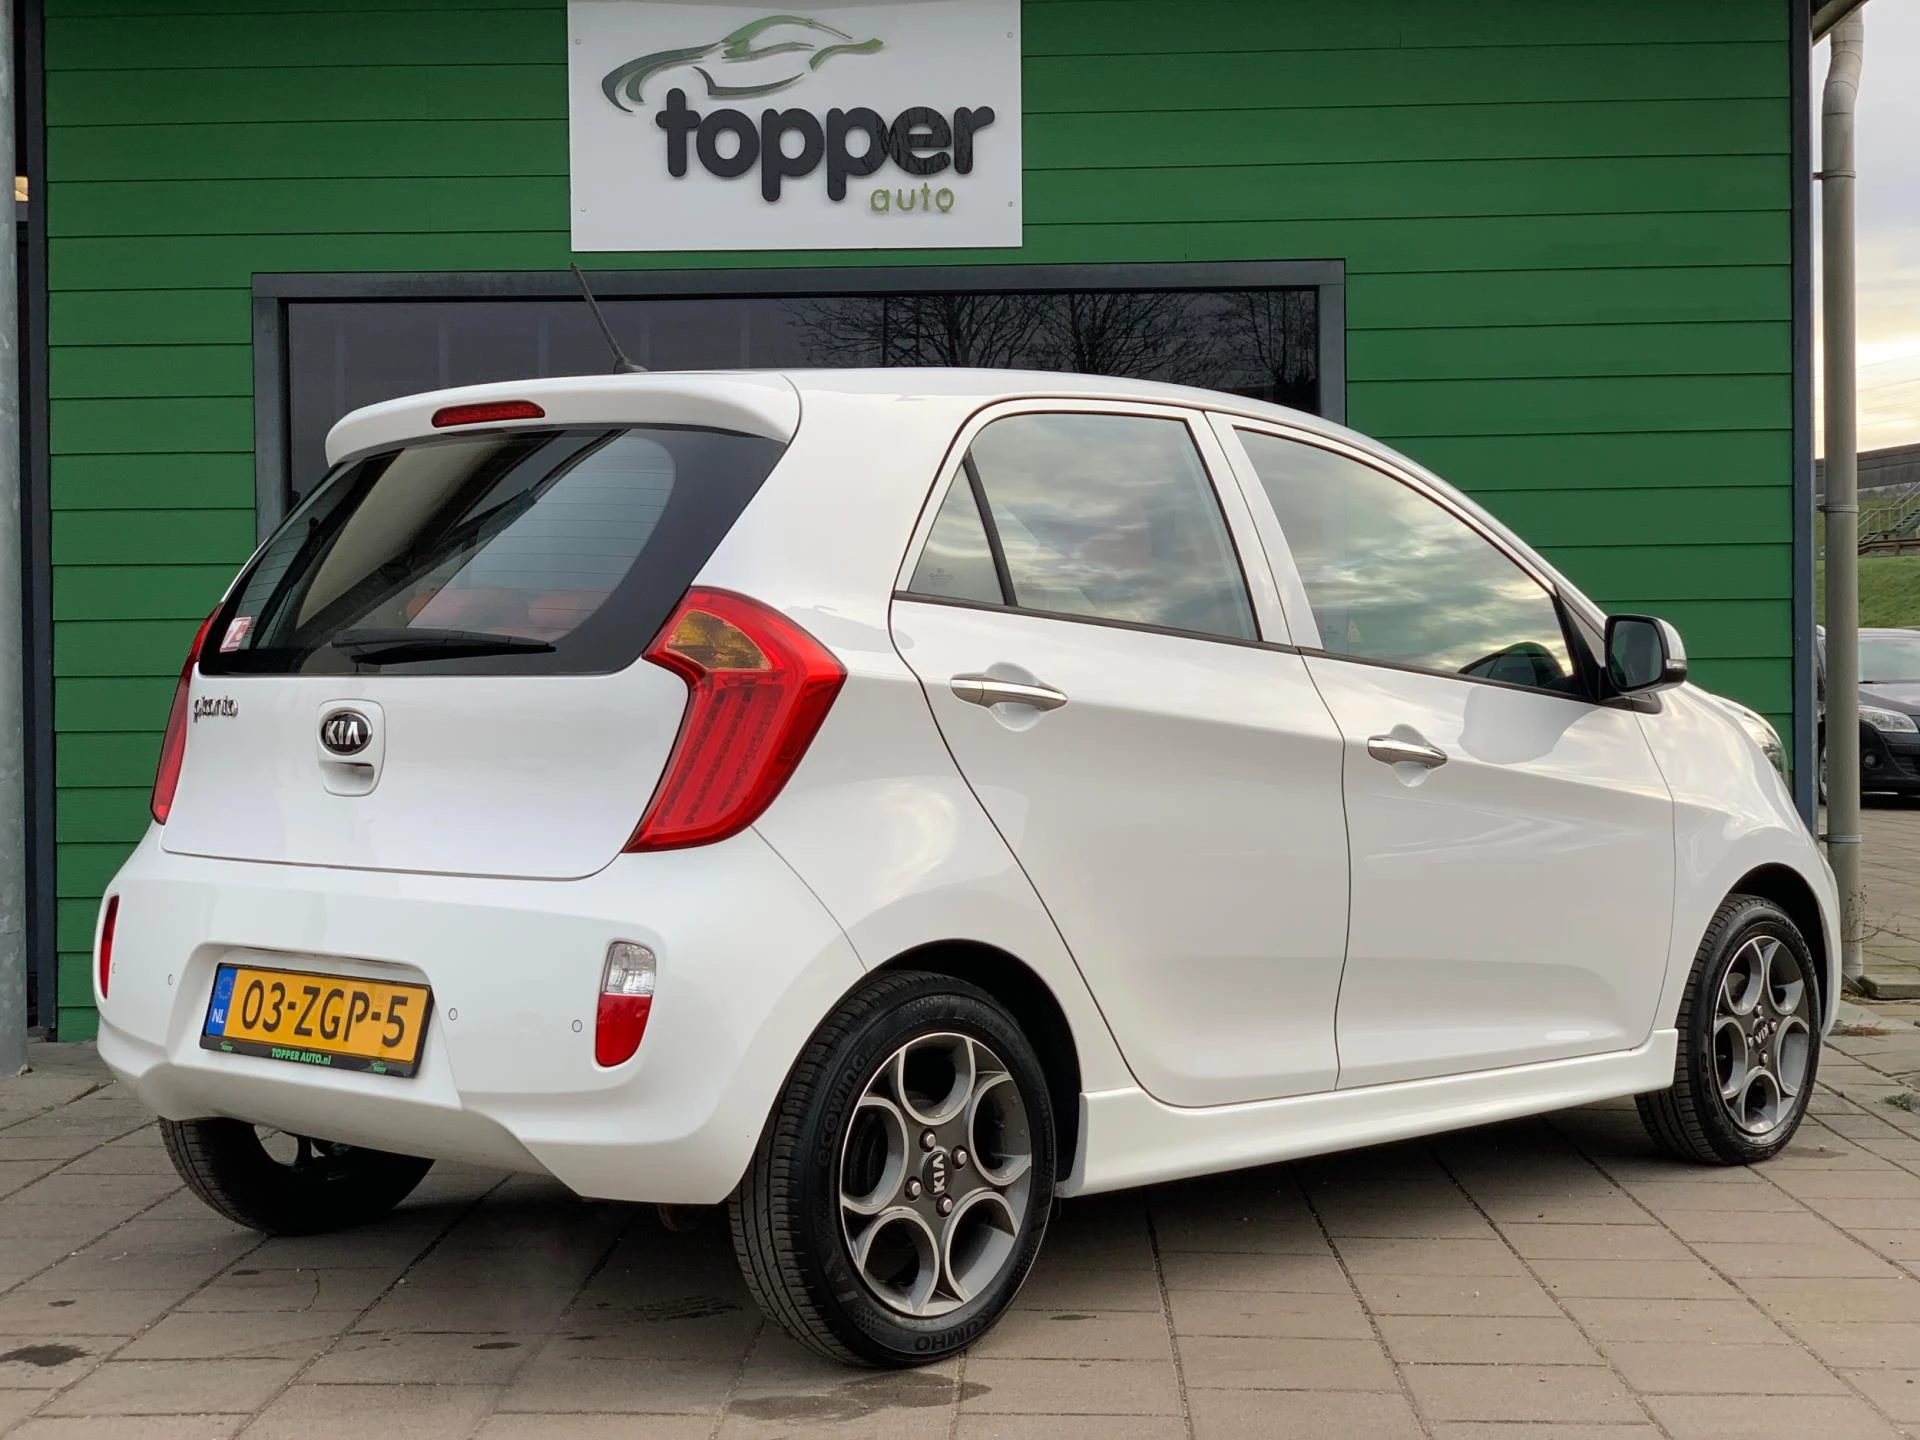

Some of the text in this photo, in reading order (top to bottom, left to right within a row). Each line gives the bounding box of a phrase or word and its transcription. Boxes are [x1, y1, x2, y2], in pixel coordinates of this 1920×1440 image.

[655, 88, 995, 202] topper
[869, 182, 955, 214] auto
[325, 720, 362, 745] KIA
[211, 1007, 225, 1024] NL
[241, 979, 409, 1048] 03-ZGP-5
[1755, 1024, 1769, 1044] KIA
[271, 1047, 332, 1066] TOPPER AUTO.nl
[932, 1154, 945, 1193] KIA
